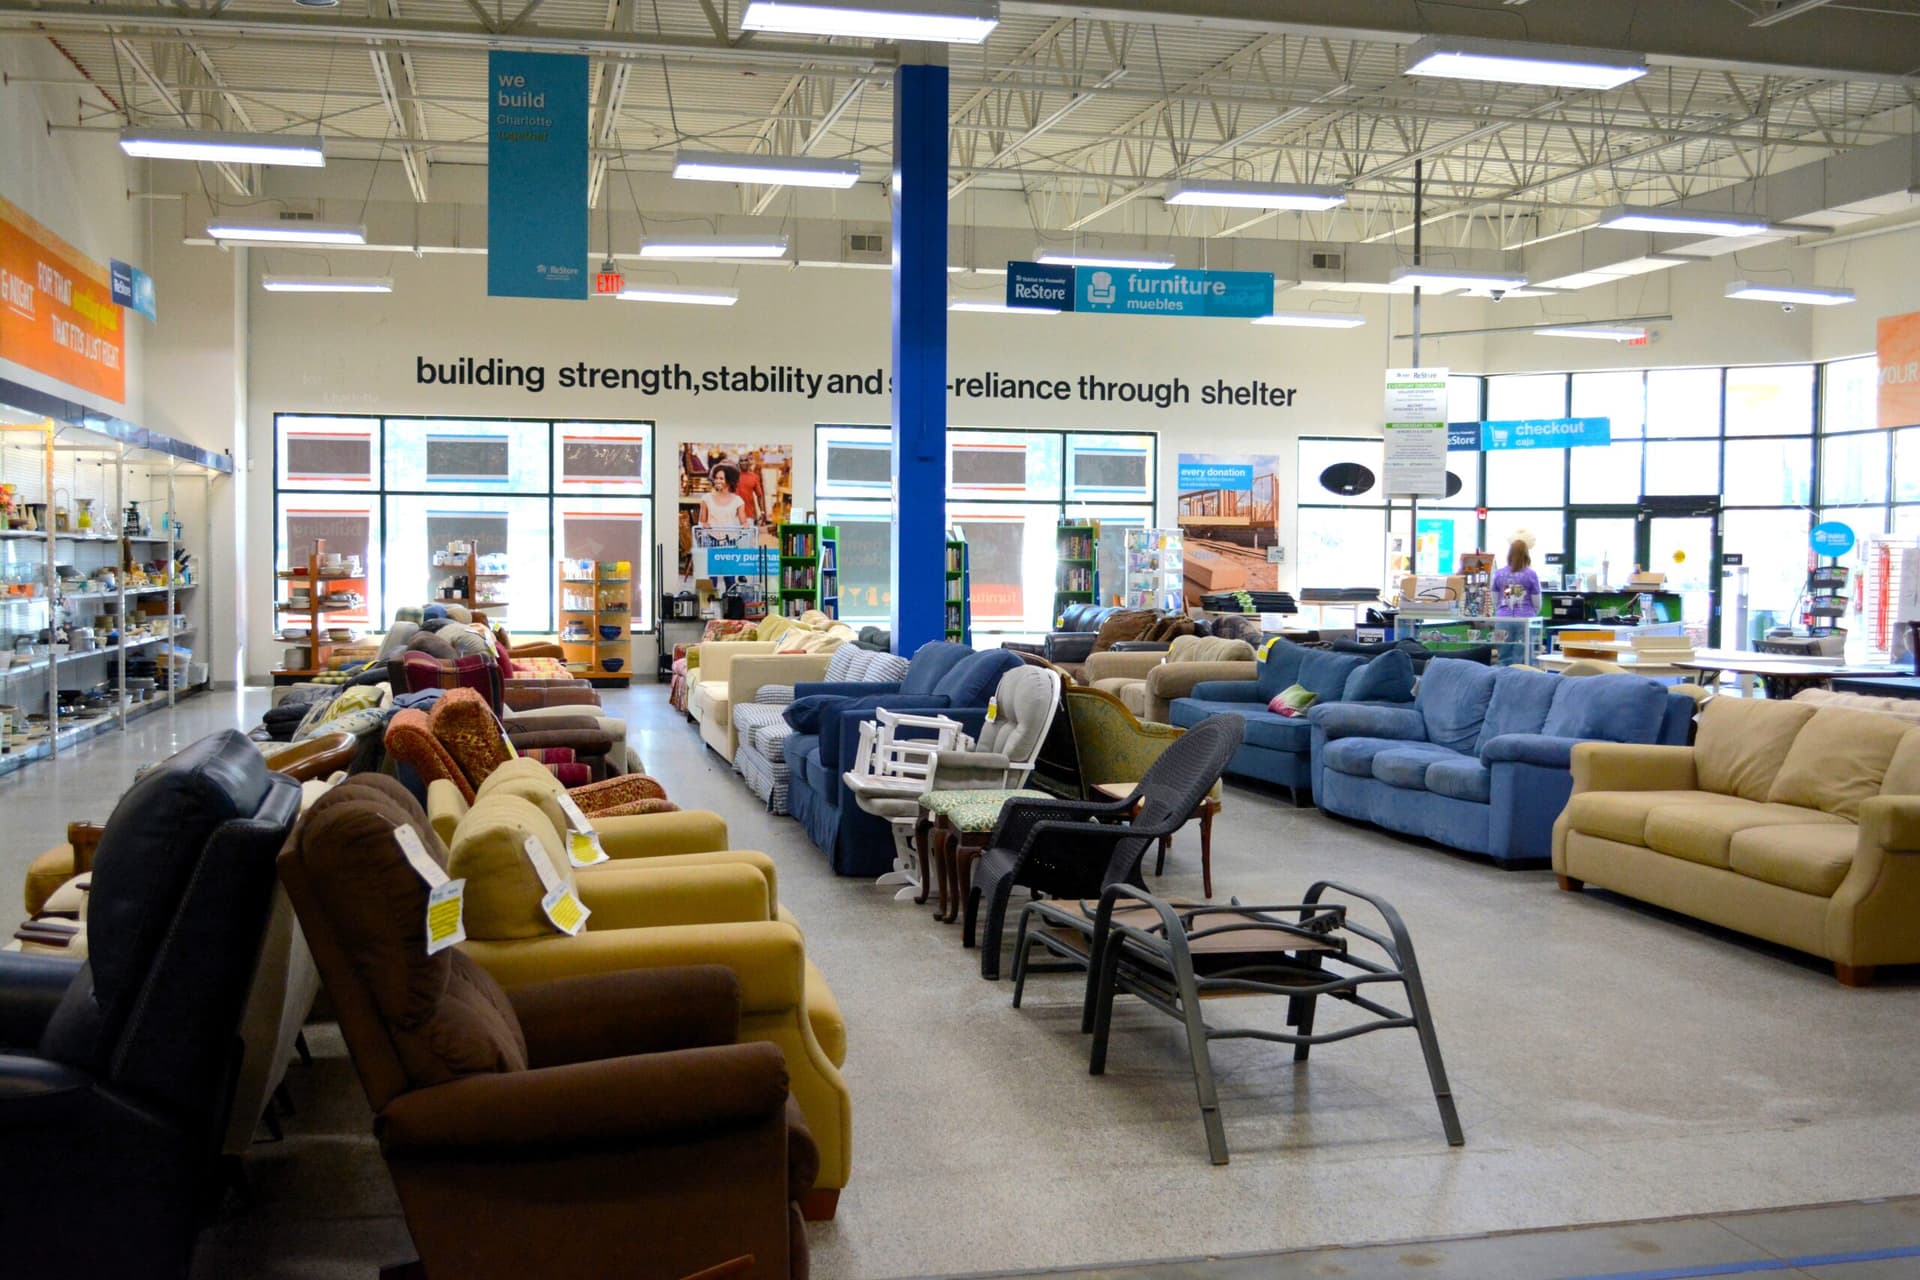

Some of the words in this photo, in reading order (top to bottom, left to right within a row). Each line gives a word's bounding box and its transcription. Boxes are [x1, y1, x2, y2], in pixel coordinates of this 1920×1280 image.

[498, 75, 525, 88] we
[498, 90, 545, 108] build
[496, 114, 552, 127] Charlotte
[596, 273, 621, 293] EXIT
[1128, 274, 1226, 296] furniture
[1015, 283, 1066, 300] ReStore
[1127, 299, 1184, 311] muebles
[416, 357, 545, 393] building
[826, 369, 883, 395] and
[1079, 375, 1190, 408] through
[1200, 379, 1297, 407] shelter
[1515, 421, 1584, 436] checkout
[1448, 435, 1476, 446] eStore
[1181, 469, 1206, 478] every
[1207, 468, 1246, 477] donation
[714, 554, 741, 563] every
